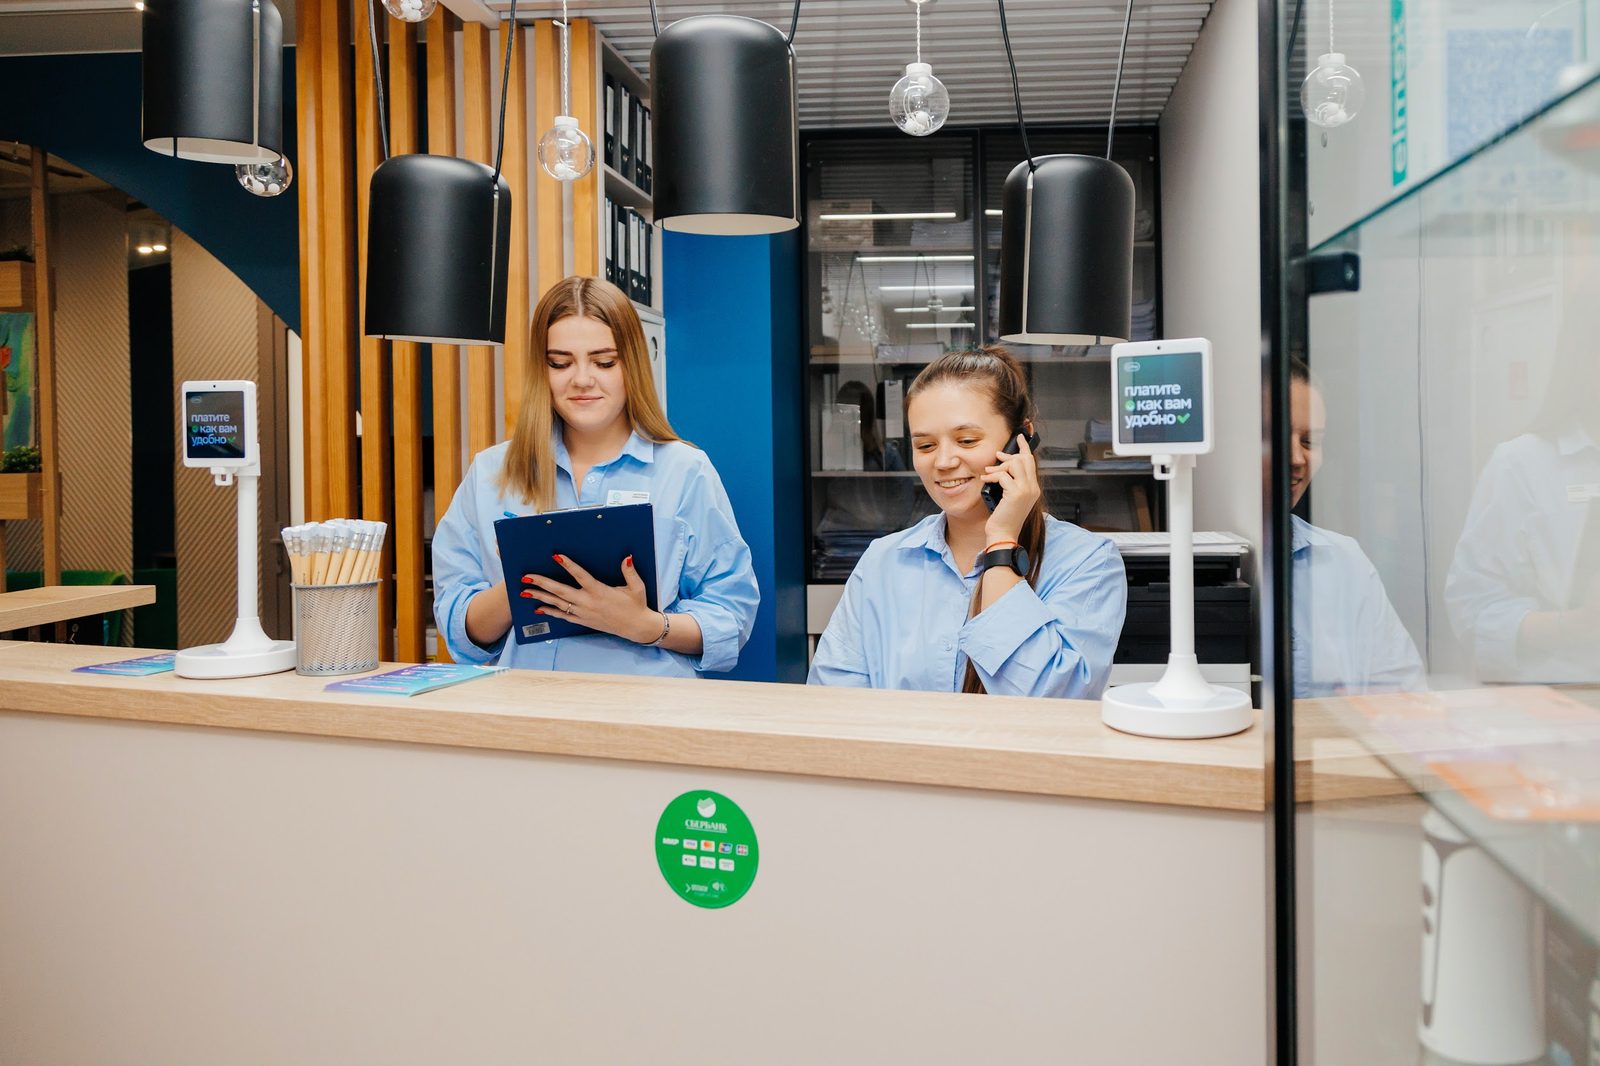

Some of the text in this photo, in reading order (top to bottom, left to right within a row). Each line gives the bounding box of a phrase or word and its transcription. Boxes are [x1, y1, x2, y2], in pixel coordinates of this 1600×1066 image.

[1124, 384, 1181, 397] платите
[1136, 398, 1192, 411] как вам
[191, 414, 230, 422] платите
[1124, 410, 1176, 429] удобно
[200, 425, 237, 433] как вам
[191, 434, 227, 447] удобно
[685, 819, 728, 832] СБЕРБАНК
